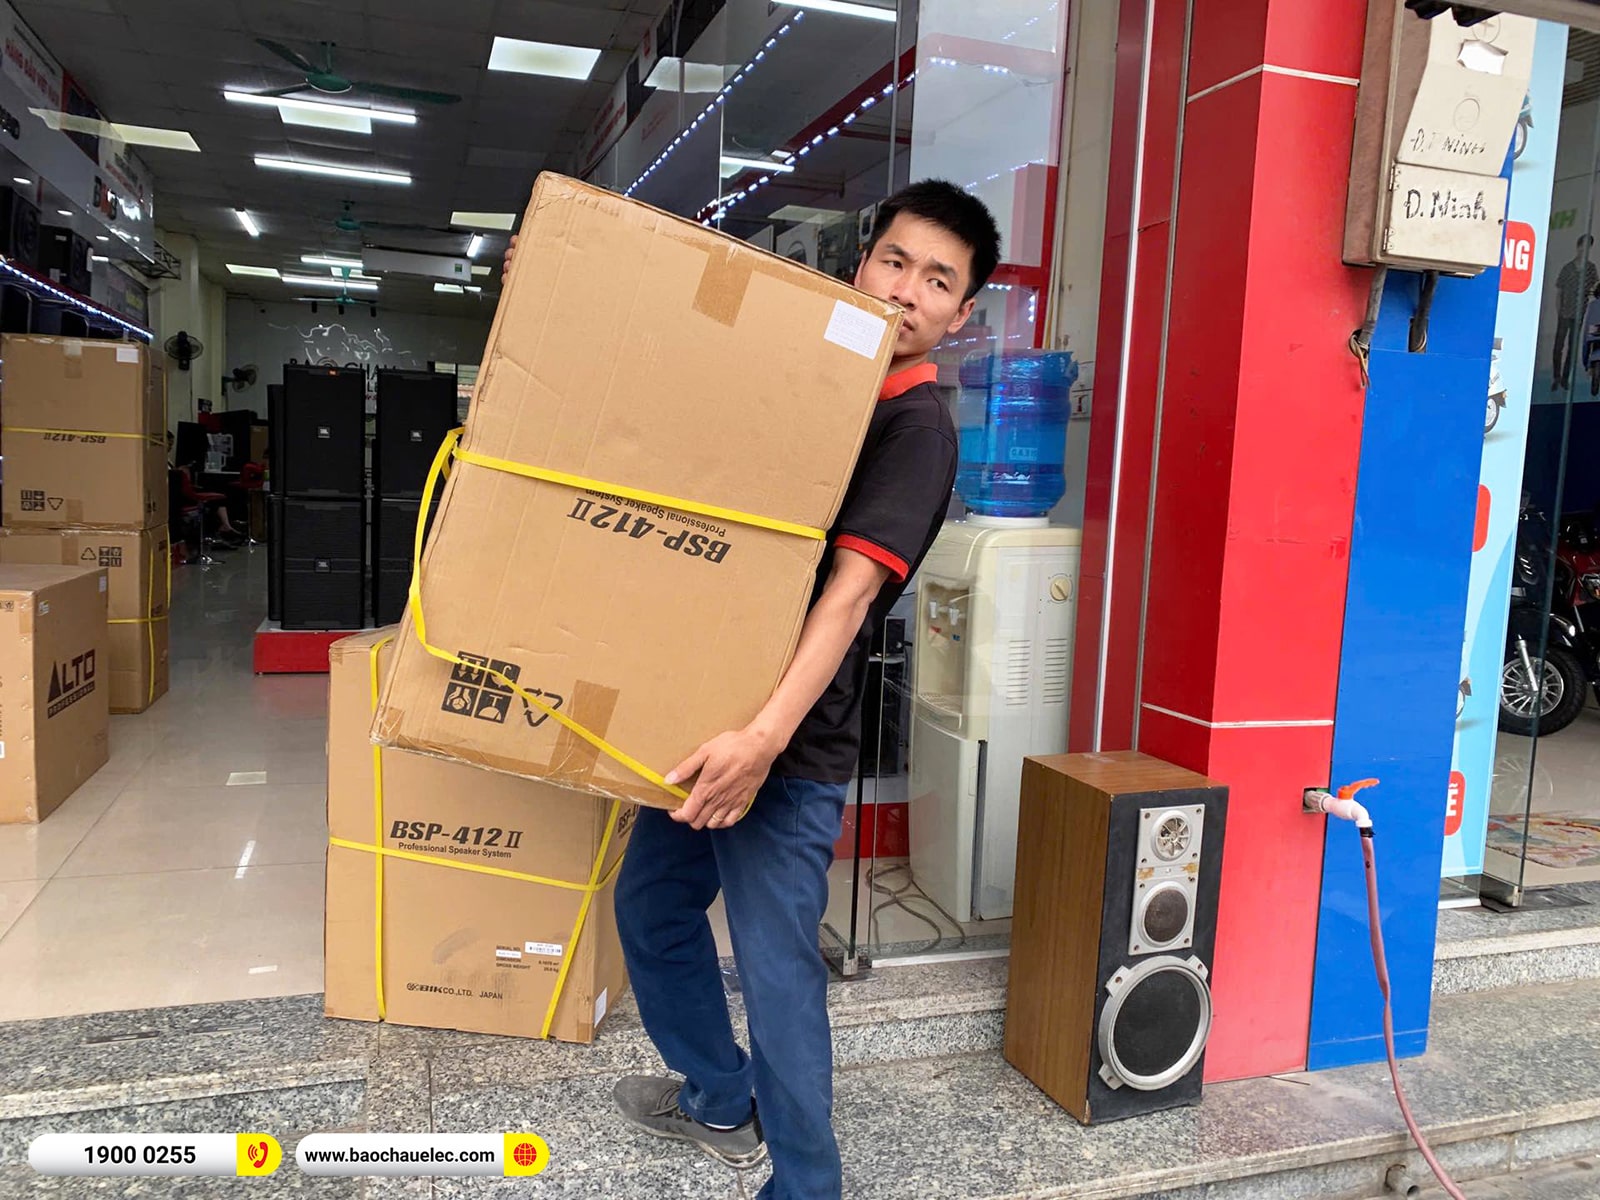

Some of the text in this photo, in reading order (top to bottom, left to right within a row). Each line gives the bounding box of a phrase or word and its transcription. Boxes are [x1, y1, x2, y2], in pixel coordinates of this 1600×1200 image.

[624, 499, 666, 519] Speaker
[666, 514, 727, 538] Professional
[47, 649, 95, 704] ALTO
[398, 842, 512, 858] Professional Speaker System
[479, 991, 503, 1000] JAPAN
